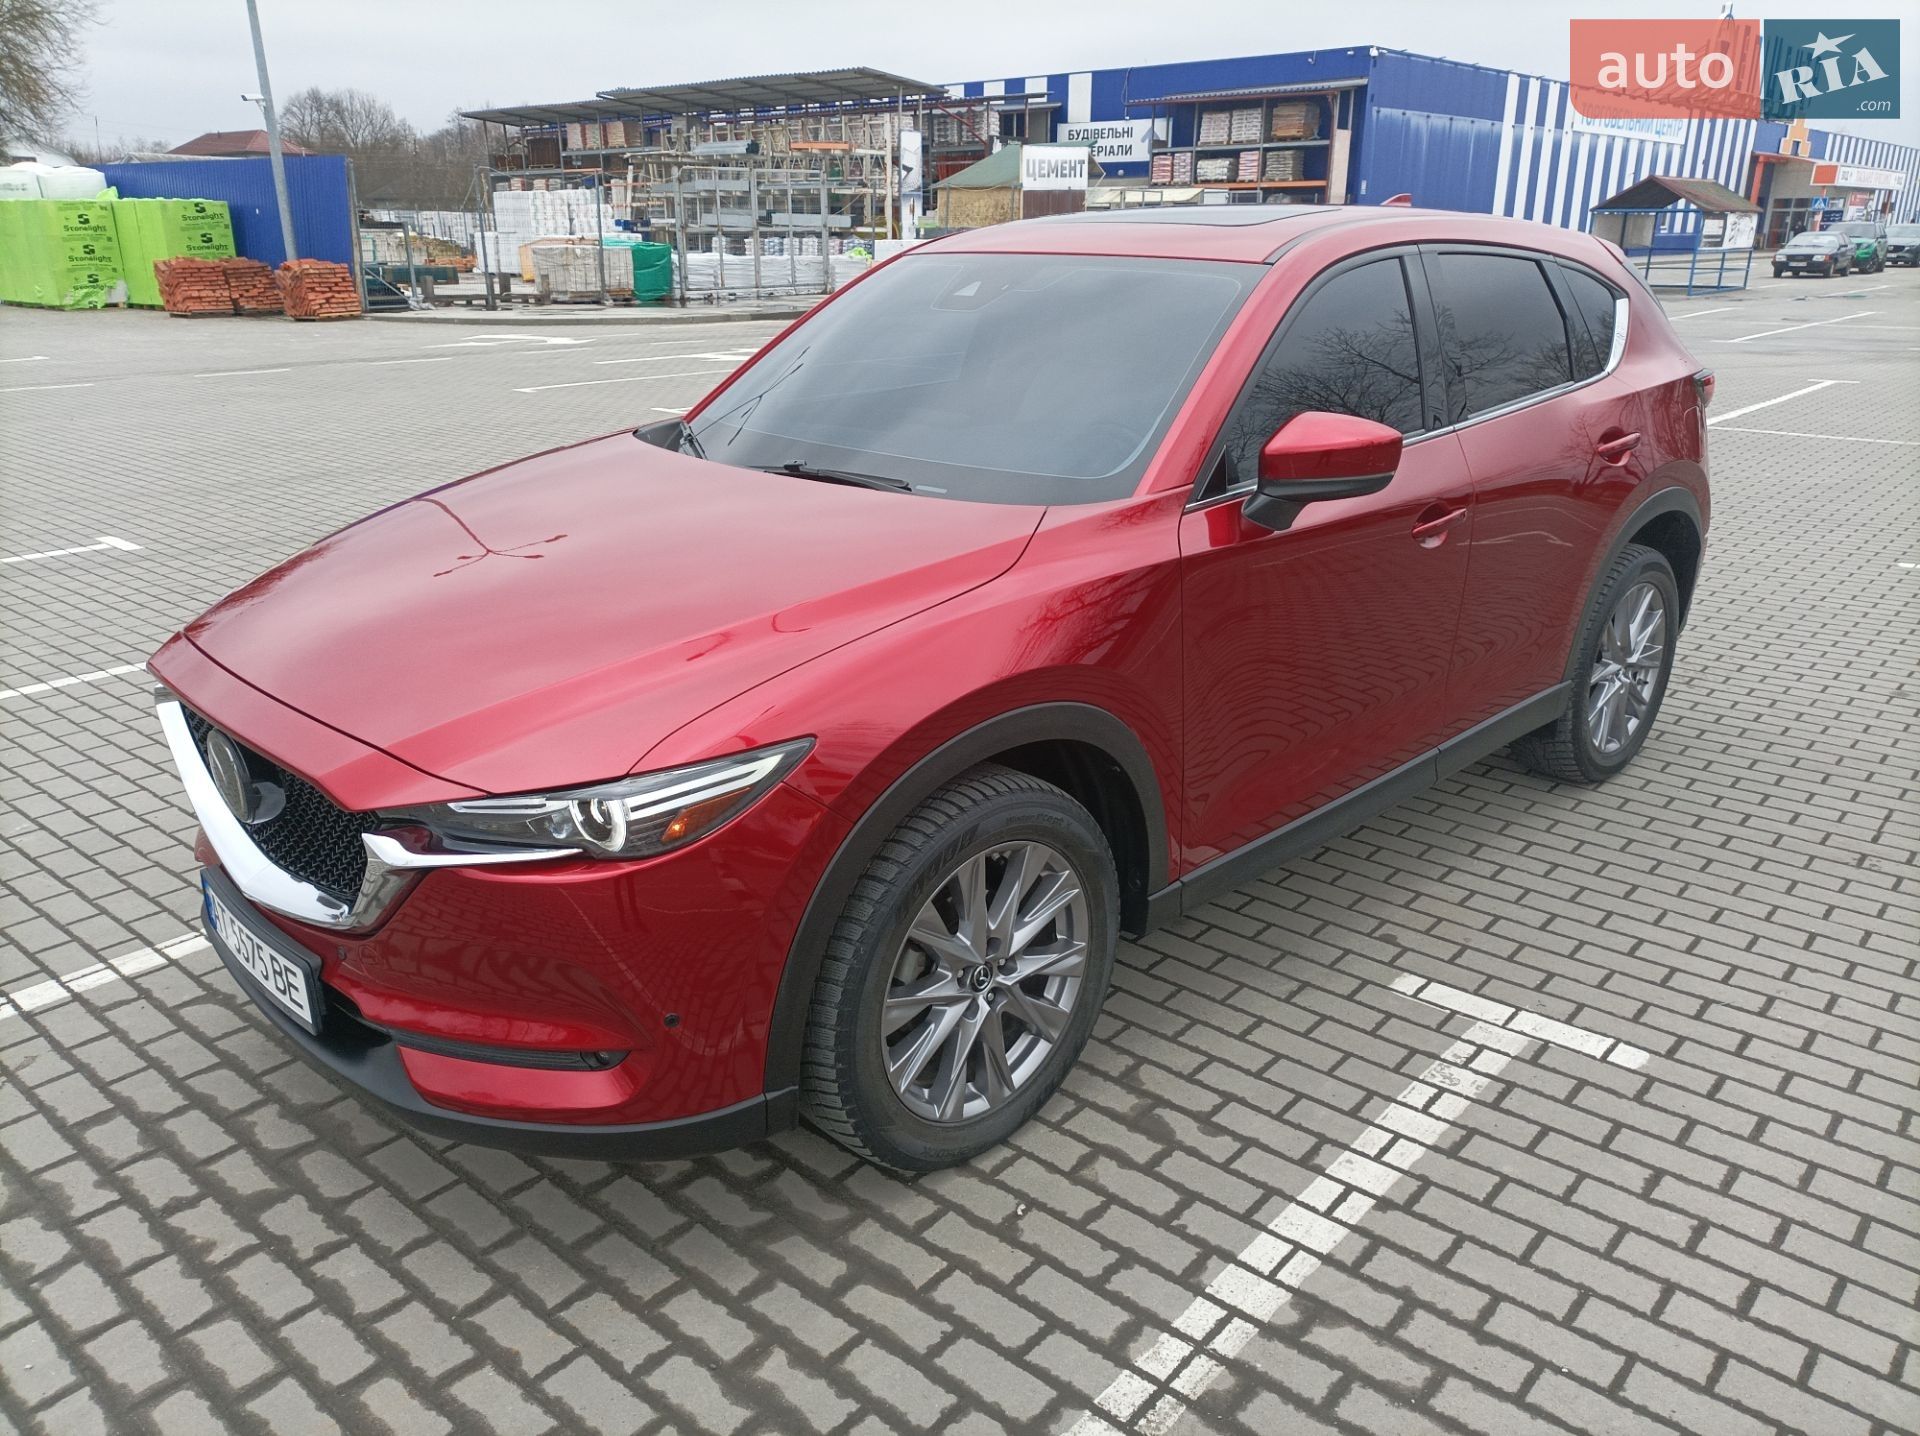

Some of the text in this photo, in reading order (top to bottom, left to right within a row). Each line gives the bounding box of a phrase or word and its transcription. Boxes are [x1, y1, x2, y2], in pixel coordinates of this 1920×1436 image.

[1068, 127, 1133, 141] БУДІВЕЛЬНІ
[1090, 144, 1133, 157] ЕРІАЛИ
[1026, 159, 1086, 181] ЦЕМЕНТ
[181, 212, 225, 221] Stonelight
[63, 224, 107, 233] Stonelight
[186, 243, 229, 252] Stonelight
[68, 255, 113, 263] Stonelight
[231, 918, 269, 981] 5575
[270, 954, 304, 1010] BE
